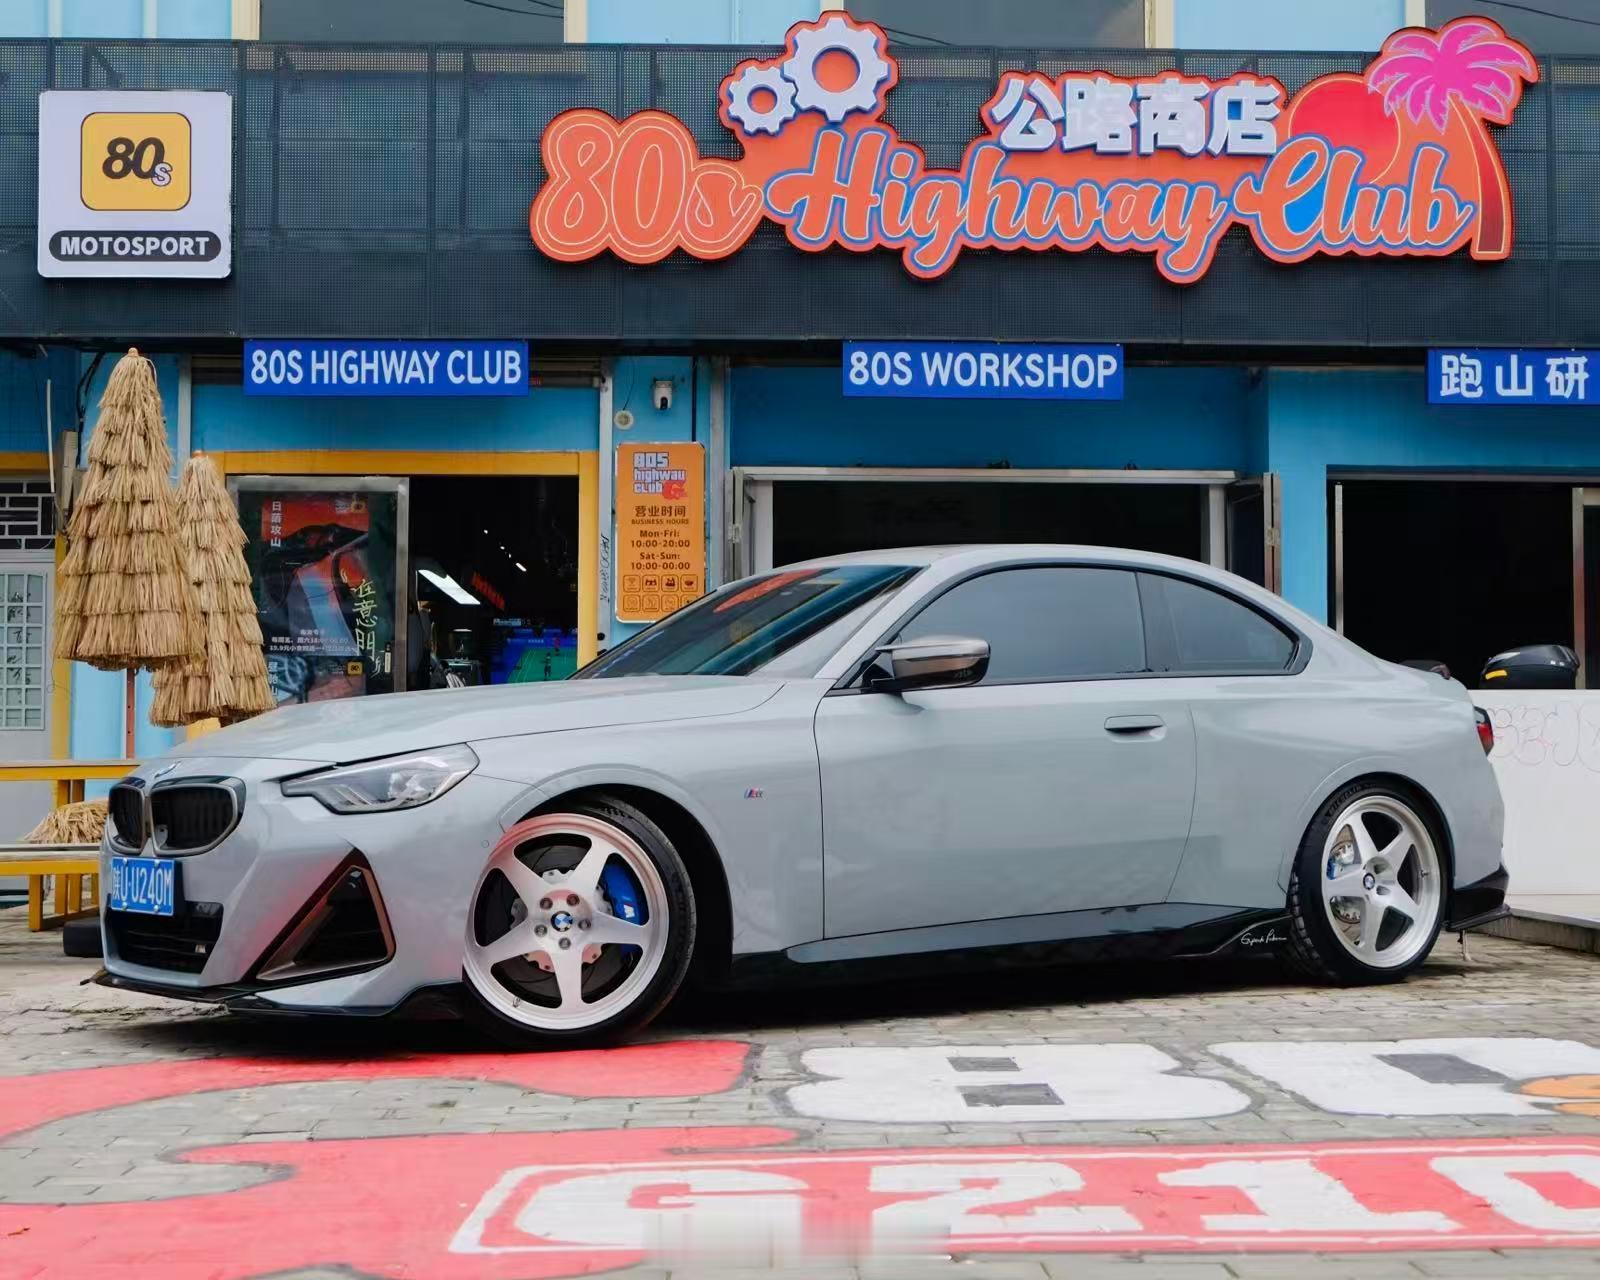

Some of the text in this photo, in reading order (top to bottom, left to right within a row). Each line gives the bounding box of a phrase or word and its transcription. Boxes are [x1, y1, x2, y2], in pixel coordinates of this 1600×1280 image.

[990, 77, 1281, 157] 公路商店
[534, 112, 1474, 273] 80s Highway Club
[60, 236, 210, 256] MOTOSPORT
[250, 349, 522, 385] 80S HIGHWAY CLUB
[848, 351, 1118, 389] 80S WORKSHOP
[1440, 353, 1590, 400] 跑山研
[634, 505, 686, 518] 营业时间
[631, 539, 690, 548] 10:00-20:00
[631, 562, 690, 570] 10:00-00:00
